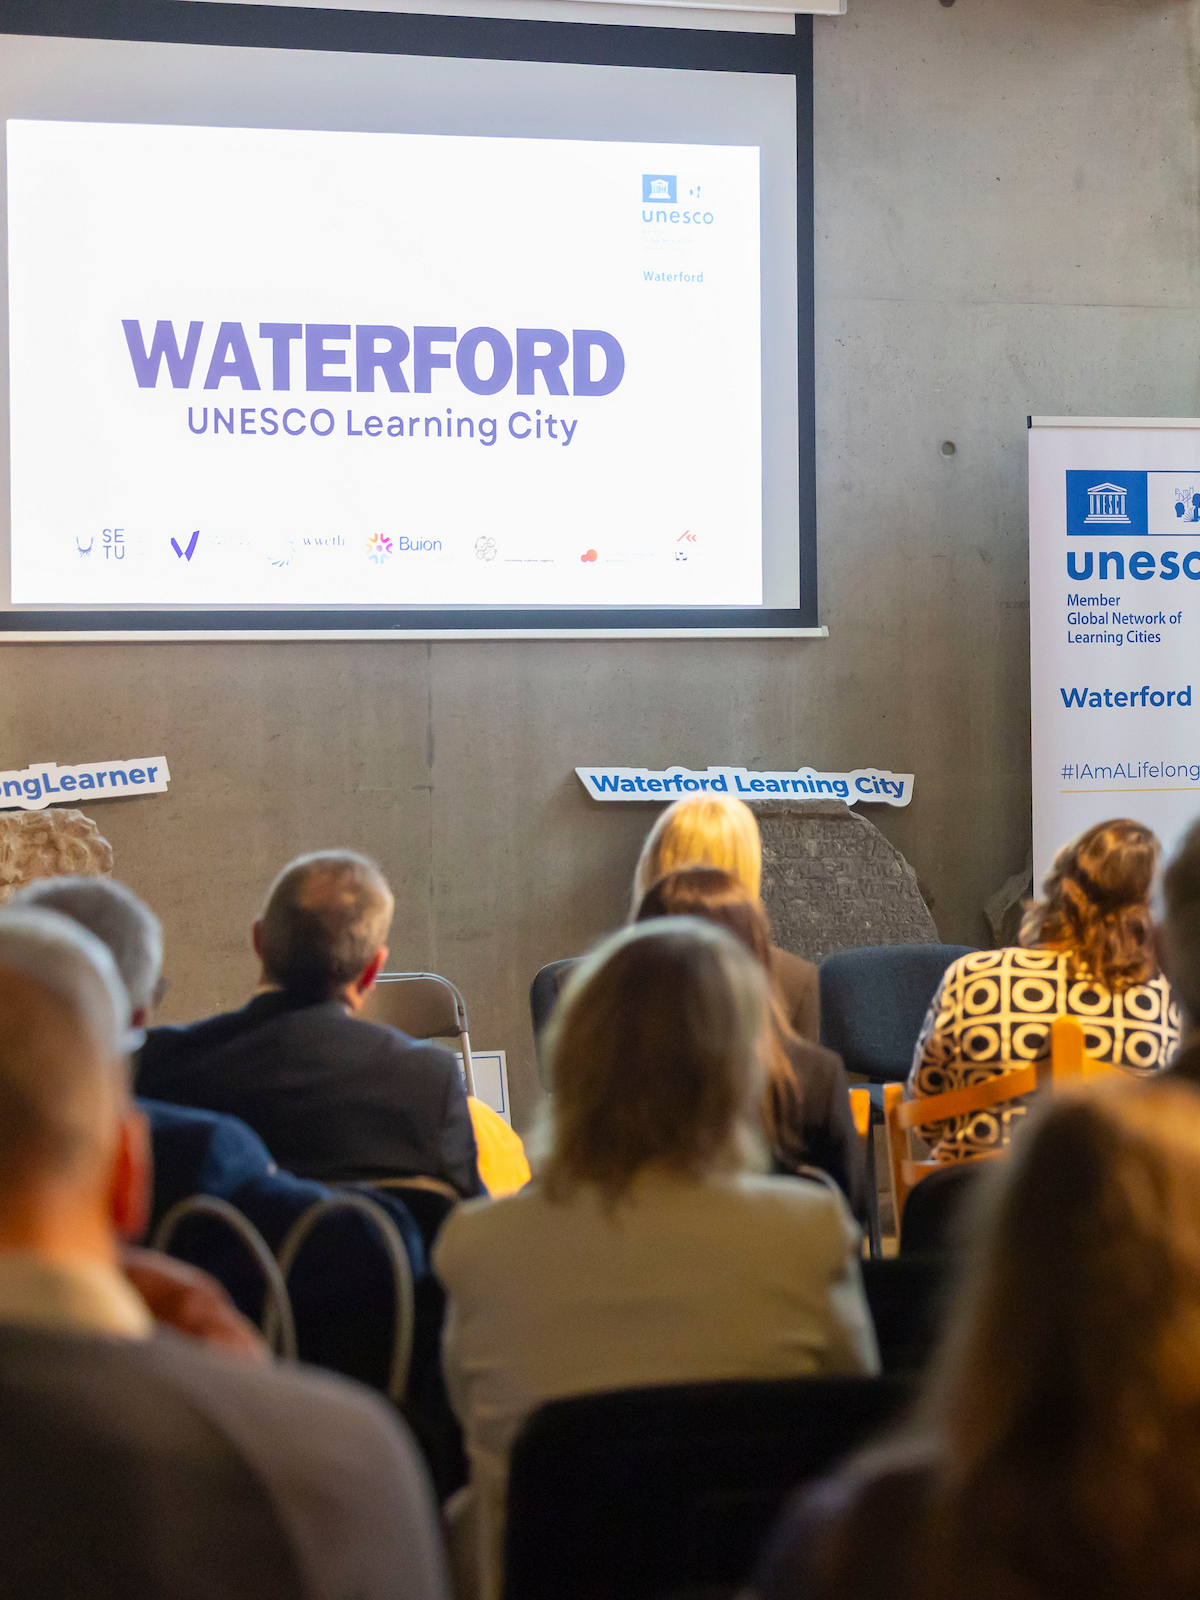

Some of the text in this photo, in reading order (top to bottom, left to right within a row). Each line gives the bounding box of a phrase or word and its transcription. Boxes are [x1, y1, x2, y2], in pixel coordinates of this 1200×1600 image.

[642, 210, 714, 225] unesco
[642, 270, 704, 283] Waterford
[121, 319, 625, 396] WATERFORD
[188, 406, 579, 446] UNESCO Learning City
[1067, 593, 1120, 607] Member
[1067, 611, 1182, 625] Global Network of
[1067, 631, 1161, 646] Learning Cities
[1060, 686, 1192, 708] Waterford
[0, 766, 158, 800] ngLearner
[590, 774, 904, 799] Waterford Learning City
